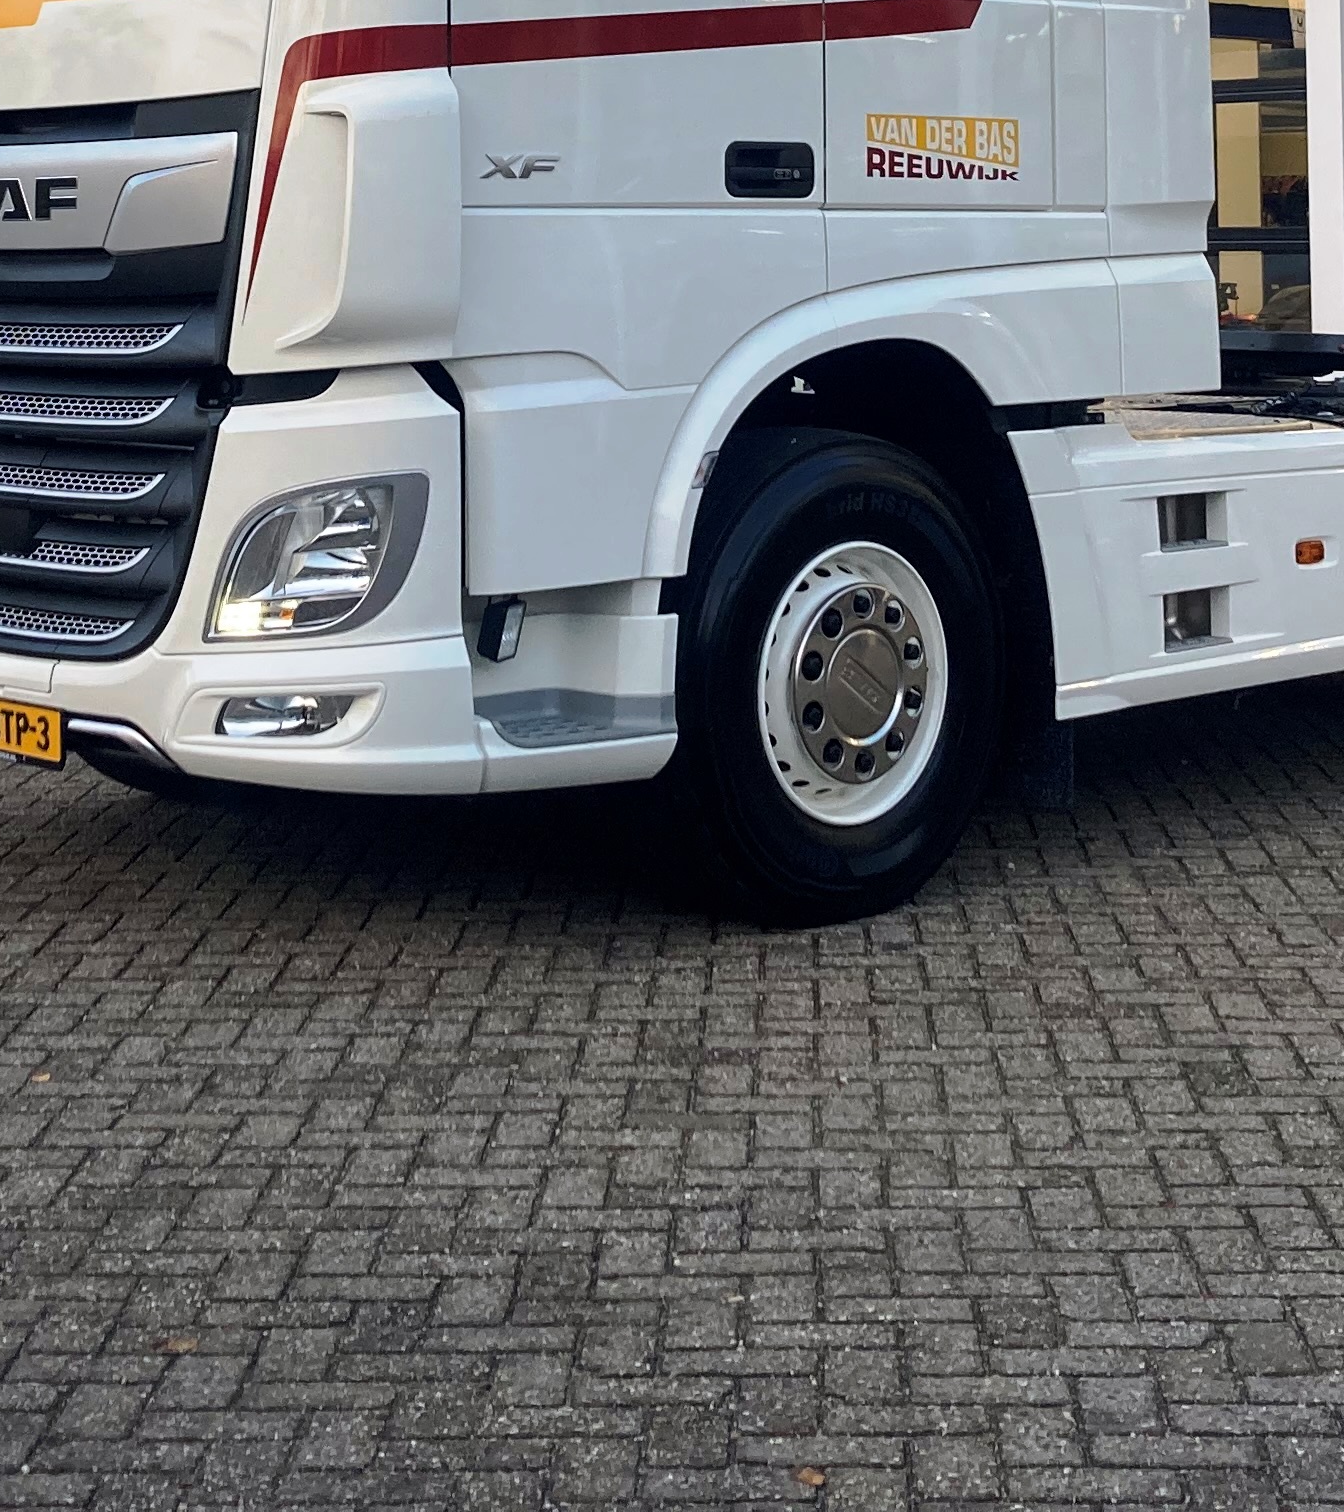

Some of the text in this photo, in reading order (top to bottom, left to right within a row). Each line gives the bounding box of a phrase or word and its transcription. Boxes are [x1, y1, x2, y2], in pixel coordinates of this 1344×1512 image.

[870, 116, 1016, 165] VAN DER BAS
[479, 153, 561, 179] XF
[867, 146, 1021, 181] REEUWIJK
